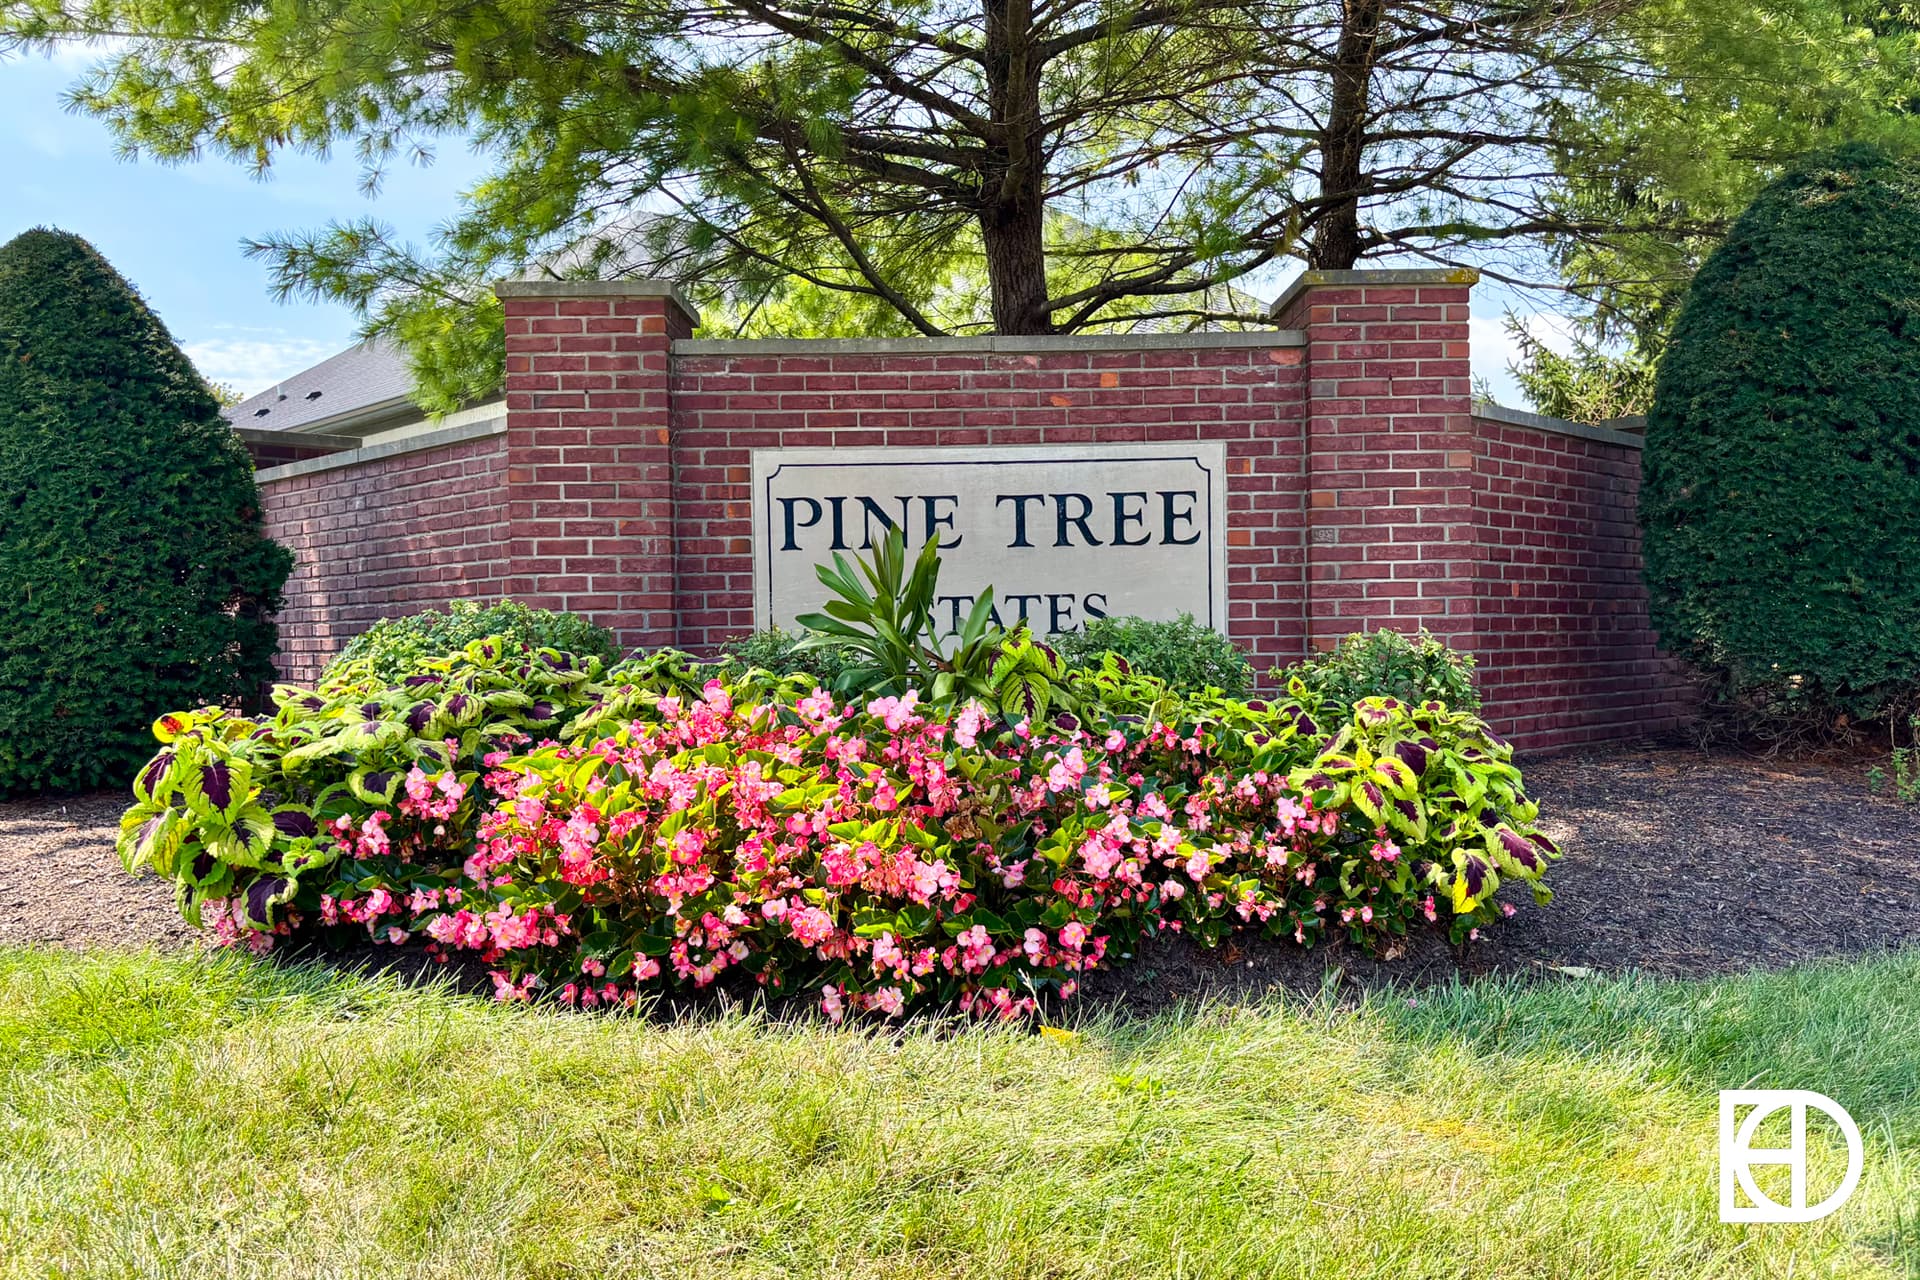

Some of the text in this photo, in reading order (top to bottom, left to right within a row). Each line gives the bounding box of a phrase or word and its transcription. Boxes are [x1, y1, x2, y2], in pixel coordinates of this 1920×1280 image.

[775, 490, 1201, 551] PINE TREE
[871, 592, 1109, 636] TATES
